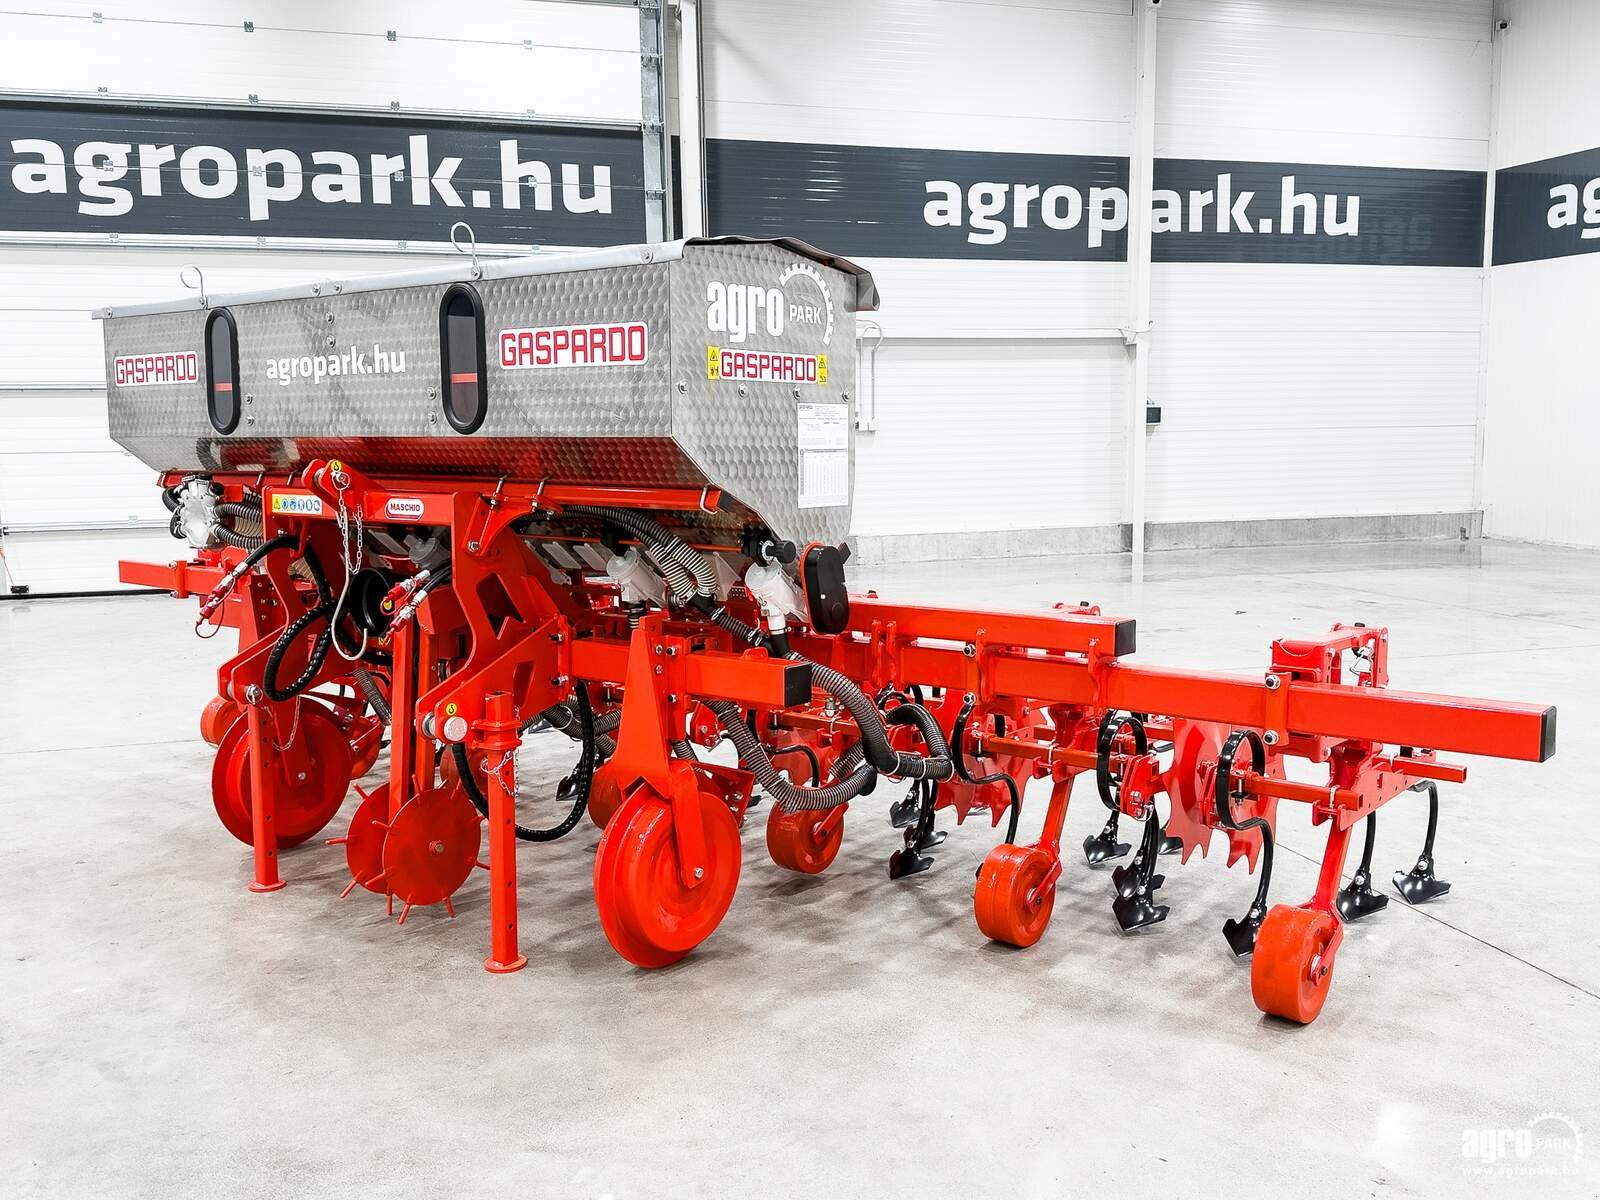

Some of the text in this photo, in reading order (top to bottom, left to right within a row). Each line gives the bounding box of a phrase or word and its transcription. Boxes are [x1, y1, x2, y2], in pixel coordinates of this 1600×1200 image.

[10, 135, 612, 221] agropark.hu
[923, 173, 1360, 248] agropark.hu
[706, 281, 822, 343] agro PARK
[266, 343, 407, 386] agropark.hu
[501, 325, 645, 366] GASPARDO
[721, 351, 817, 382] GASPARDO
[115, 353, 198, 385] GASPARDO
[390, 502, 421, 512] MASCHIO
